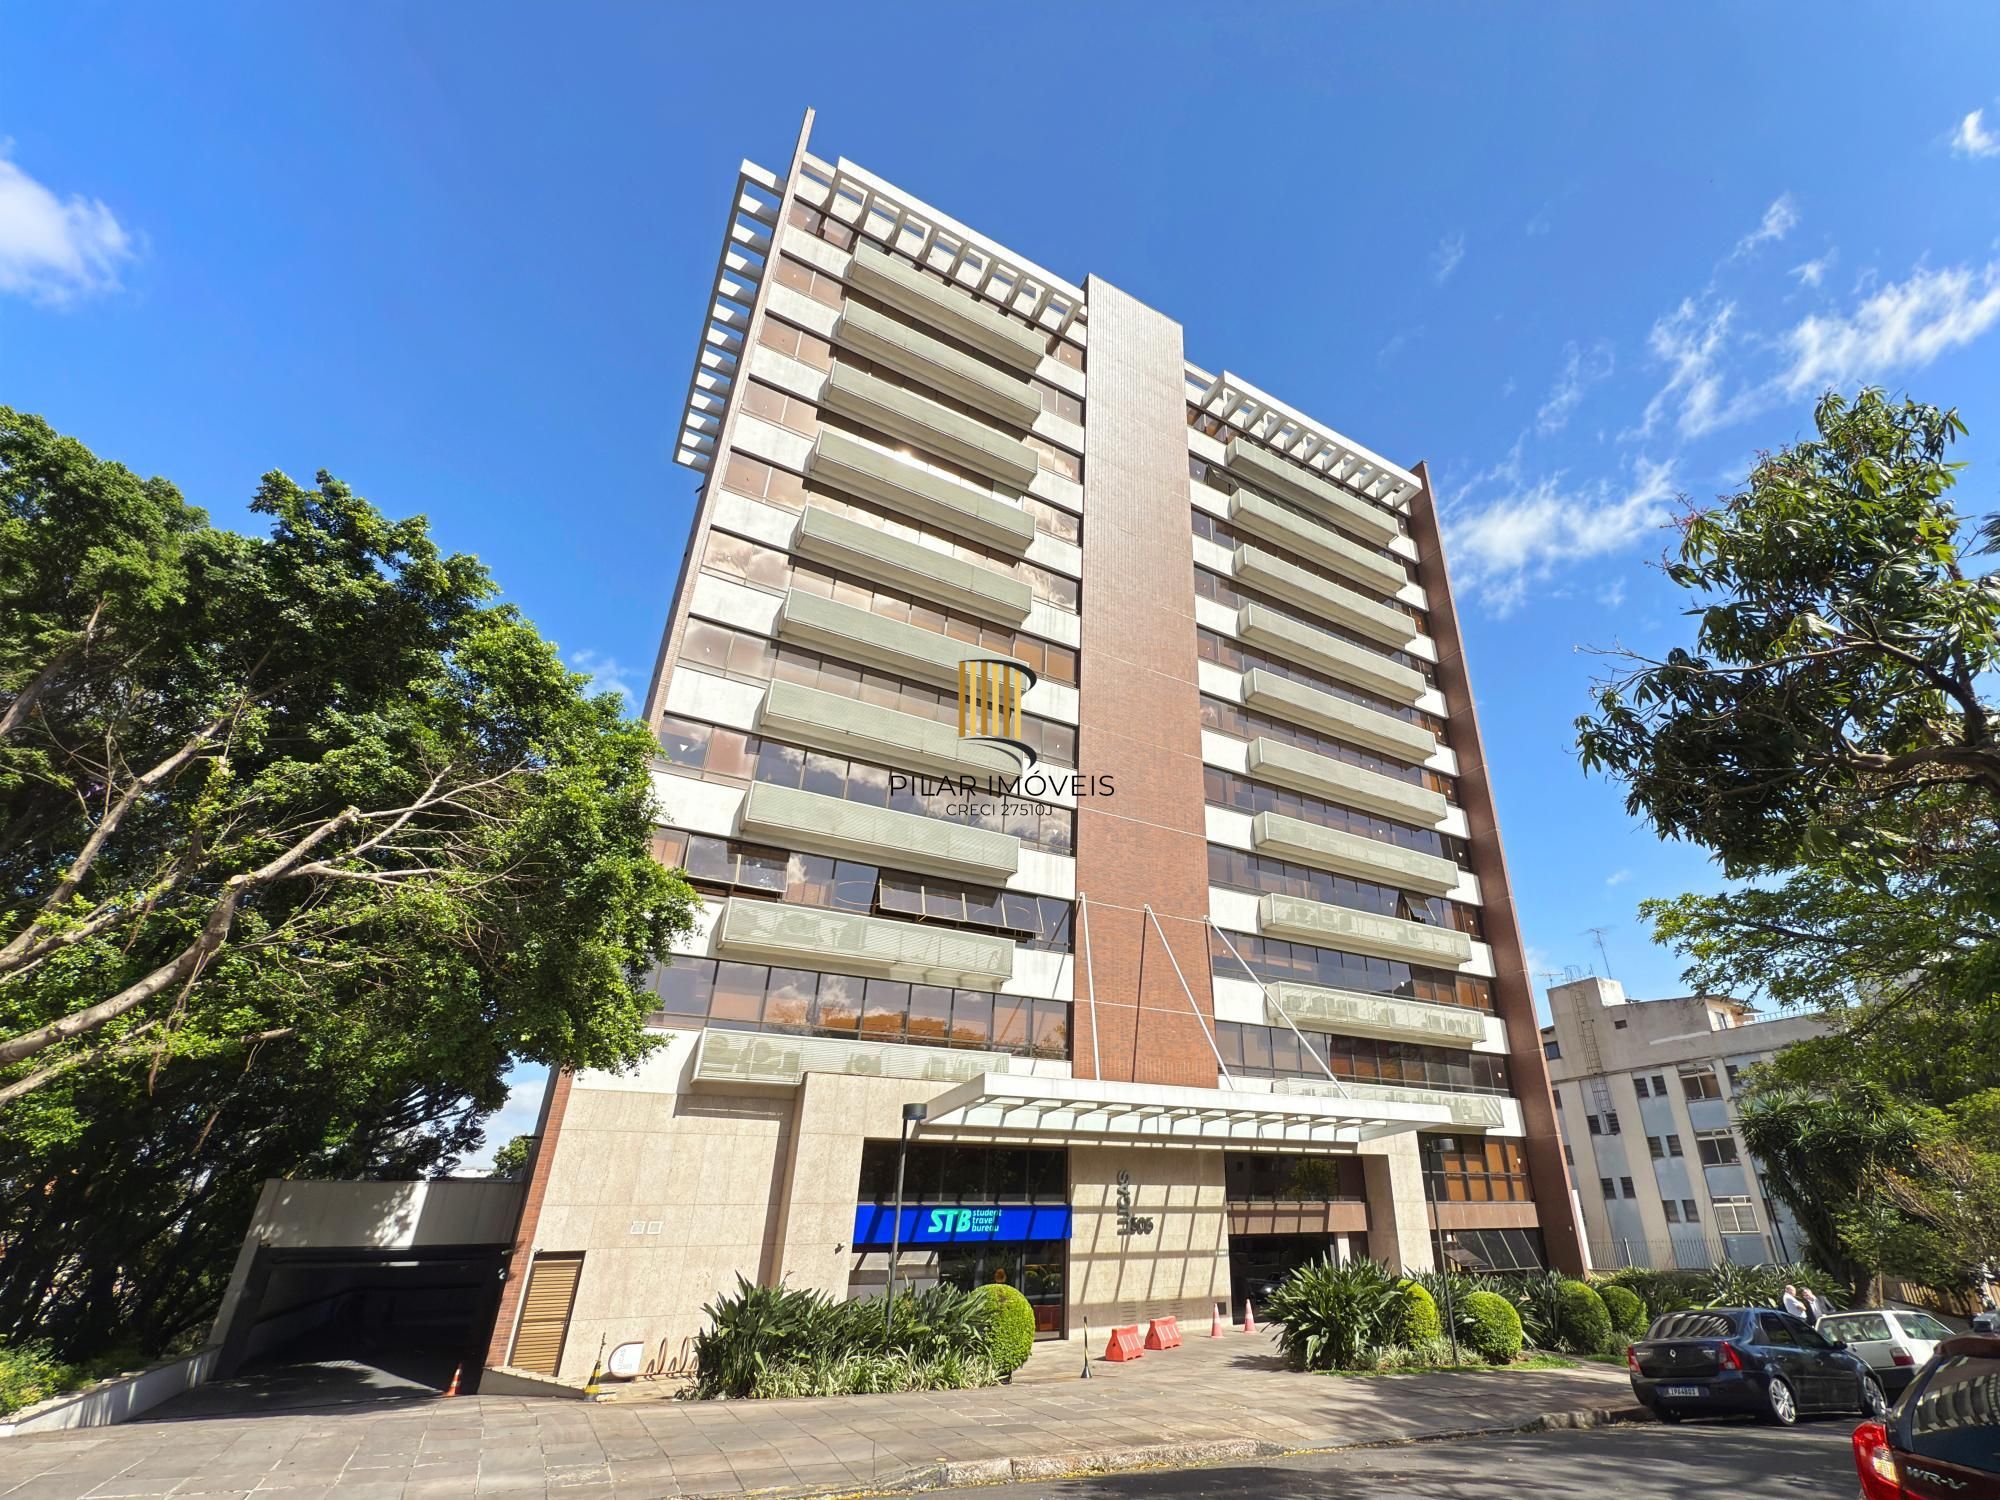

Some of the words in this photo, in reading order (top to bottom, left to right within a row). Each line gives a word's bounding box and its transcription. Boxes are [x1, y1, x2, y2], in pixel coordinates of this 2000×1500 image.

[972, 1208, 1002, 1217] student
[927, 1208, 972, 1233] STB
[972, 1216, 996, 1224] travel
[971, 1224, 1000, 1232] bureau
[1906, 1465, 1968, 1490] WR-V
